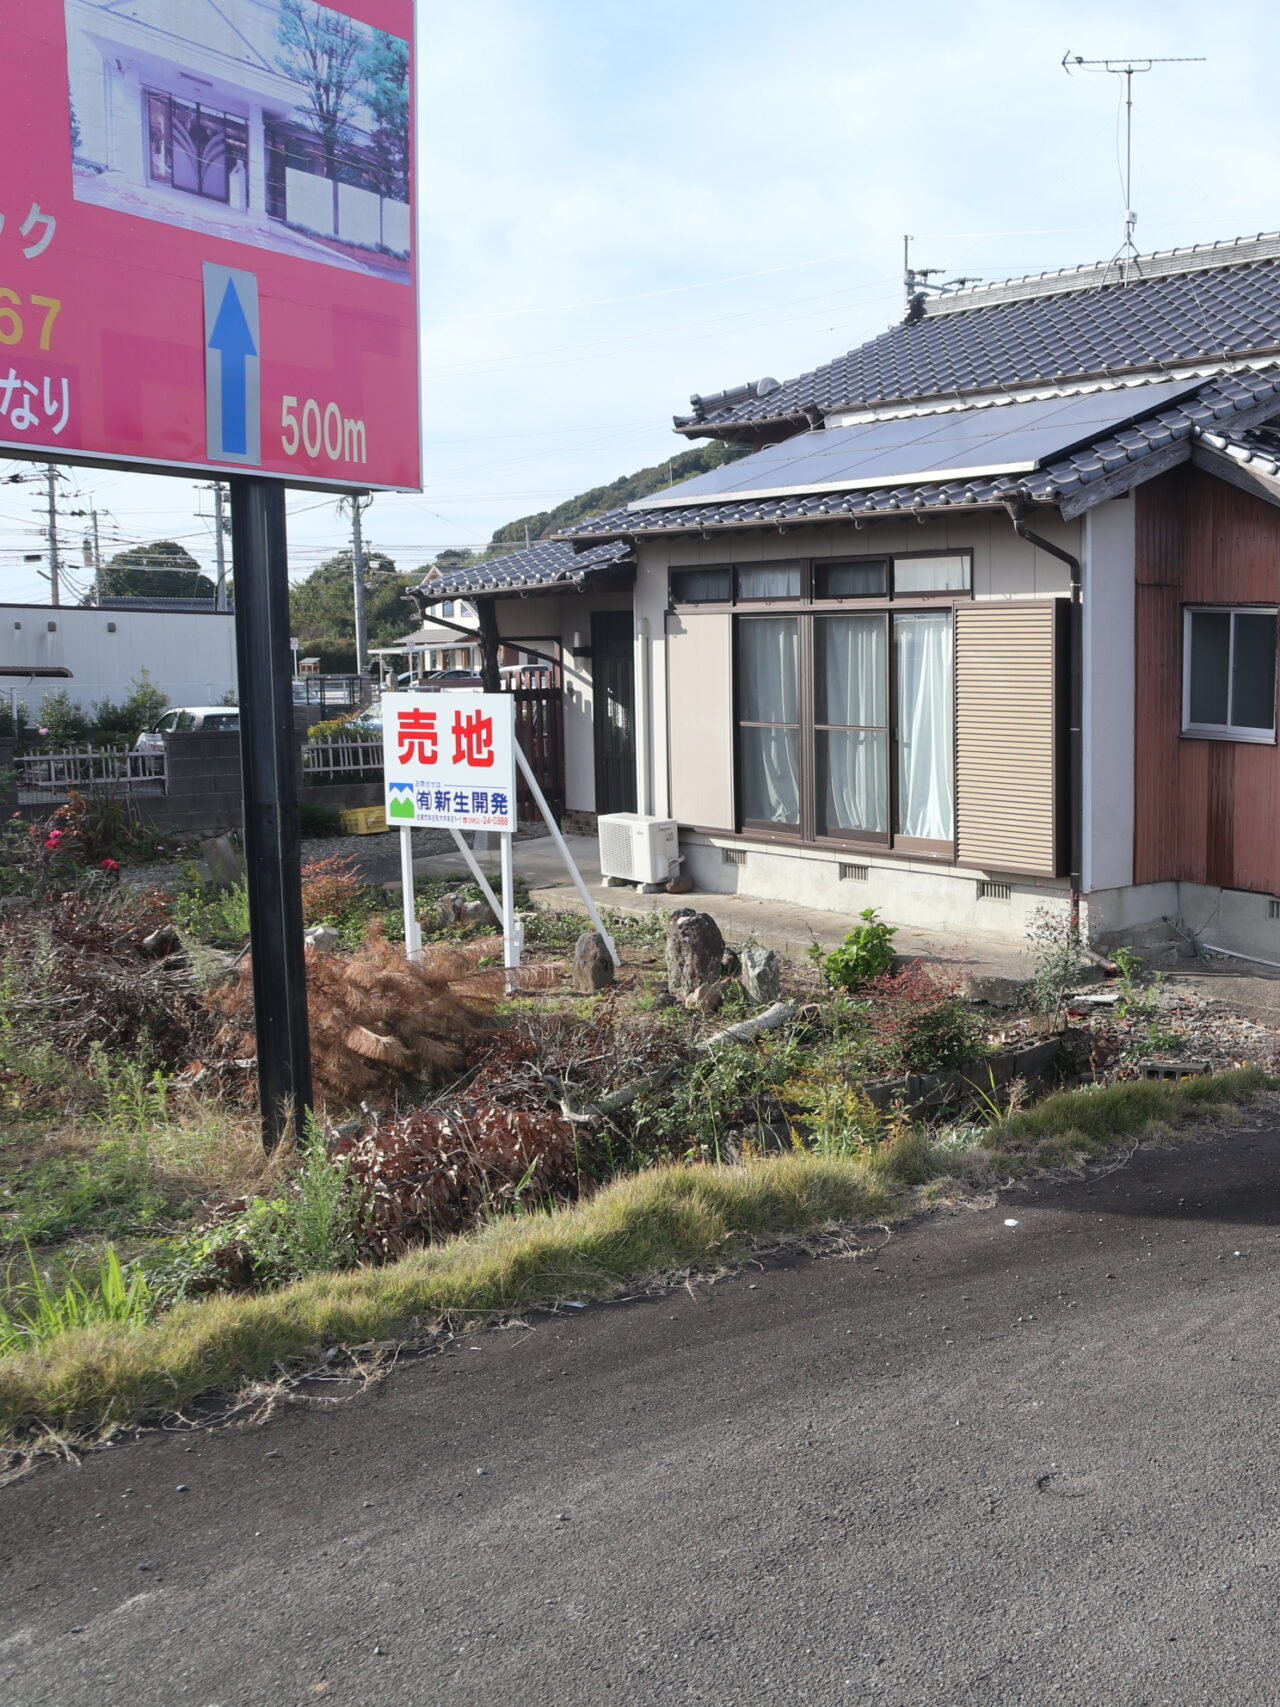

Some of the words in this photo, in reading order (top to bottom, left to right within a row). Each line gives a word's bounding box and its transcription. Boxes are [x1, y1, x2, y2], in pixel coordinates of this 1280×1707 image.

[0, 203, 57, 259] ク
[0, 287, 61, 350] 67
[0, 368, 70, 435] なり
[281, 395, 367, 464] 500m
[397, 707, 494, 768] 売地
